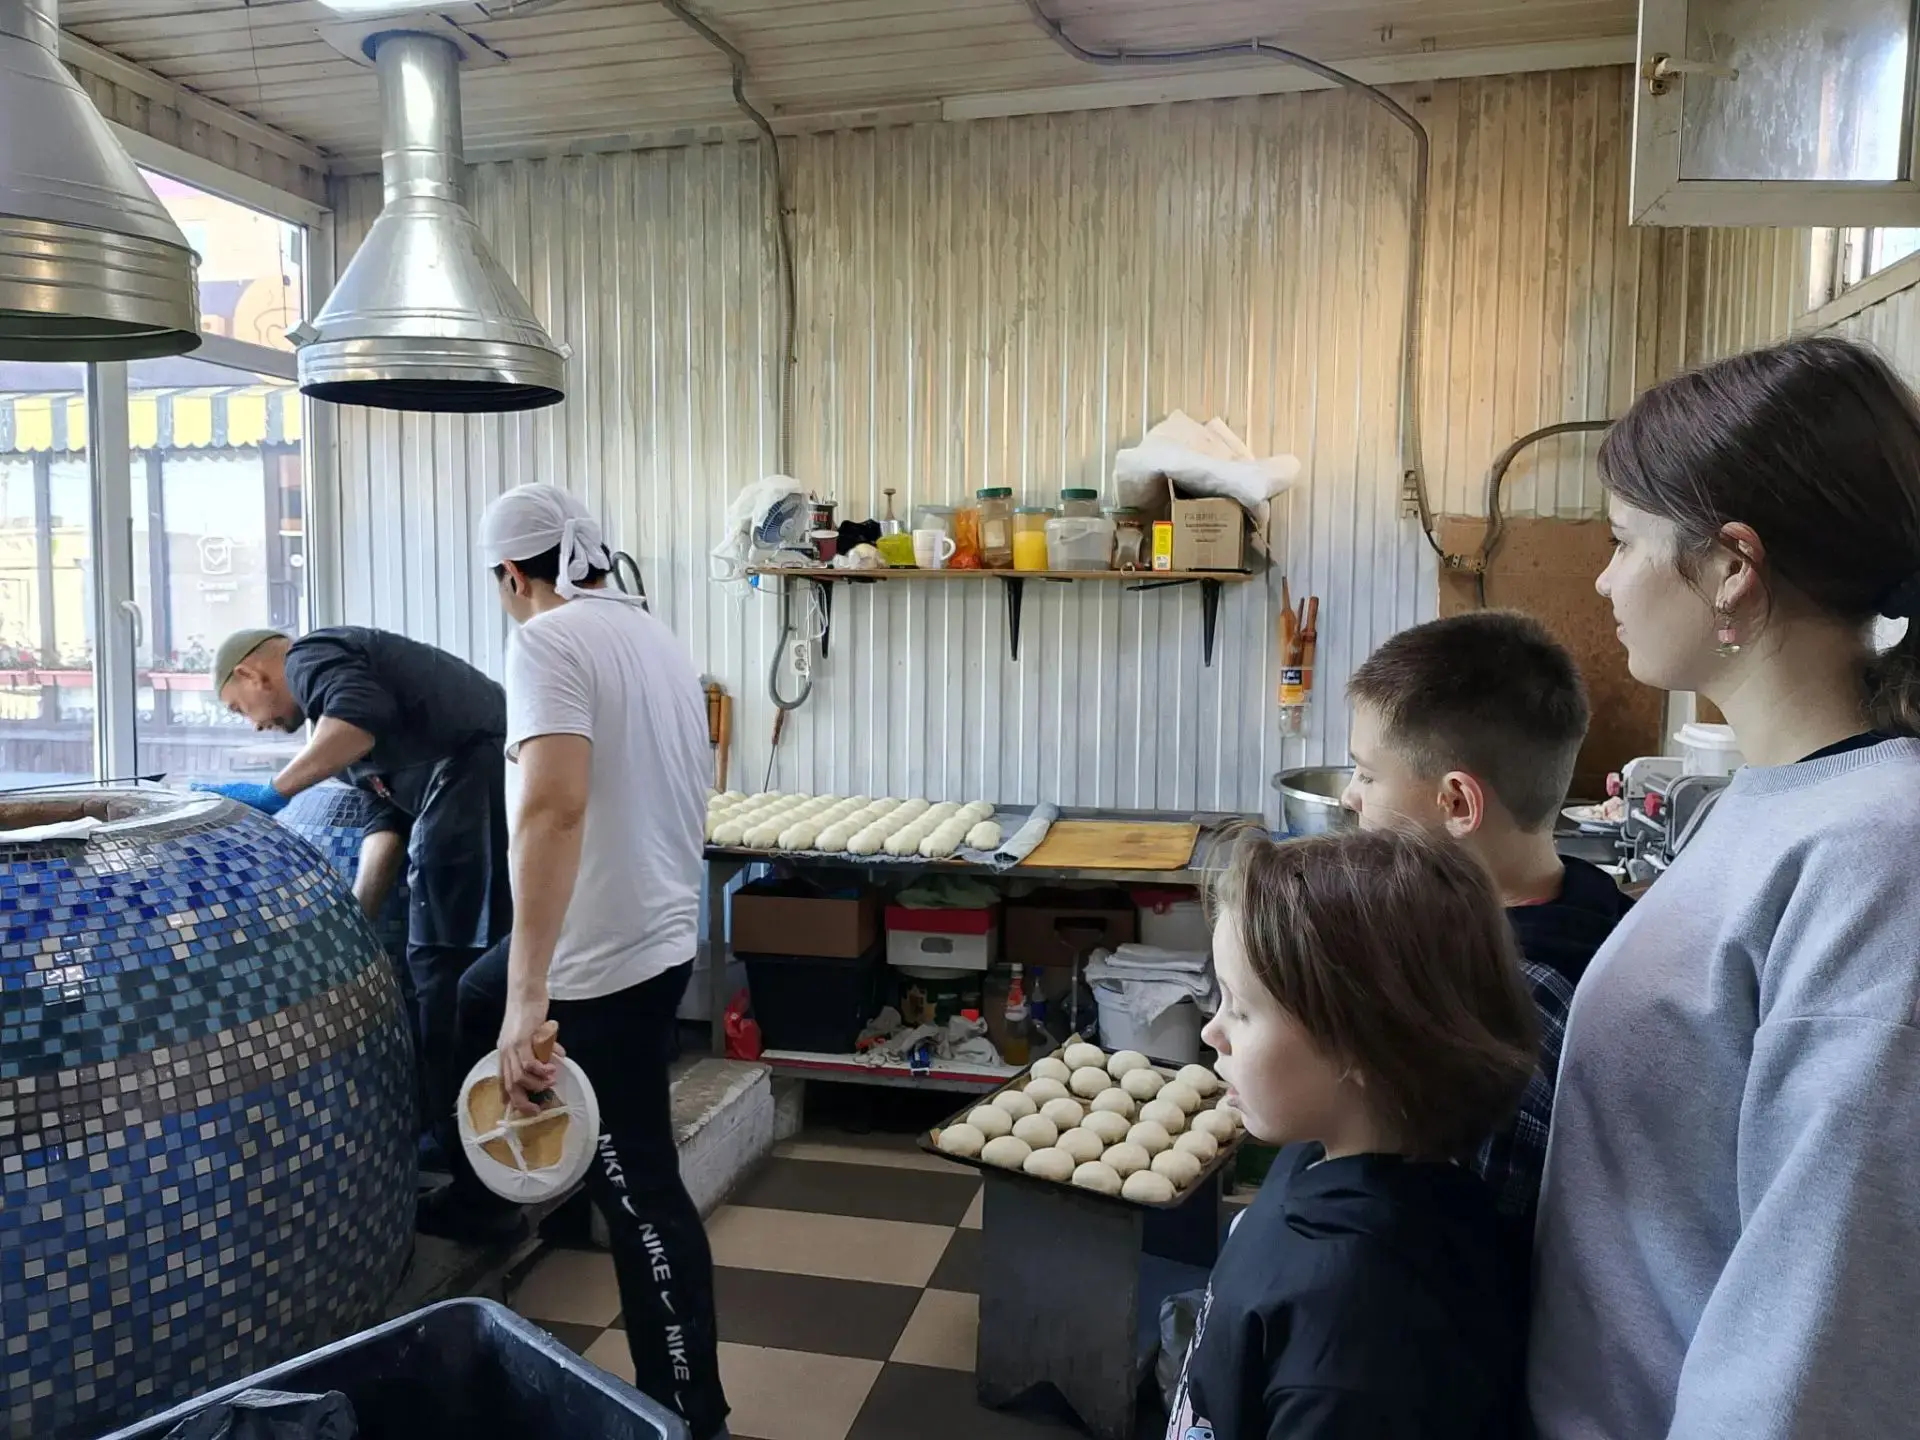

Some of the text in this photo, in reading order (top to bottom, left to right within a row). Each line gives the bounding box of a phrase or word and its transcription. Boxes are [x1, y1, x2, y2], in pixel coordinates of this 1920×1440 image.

[598, 1133, 627, 1189] NIKE
[638, 1223, 672, 1282] NIKE
[665, 1325, 690, 1381] NIKE
